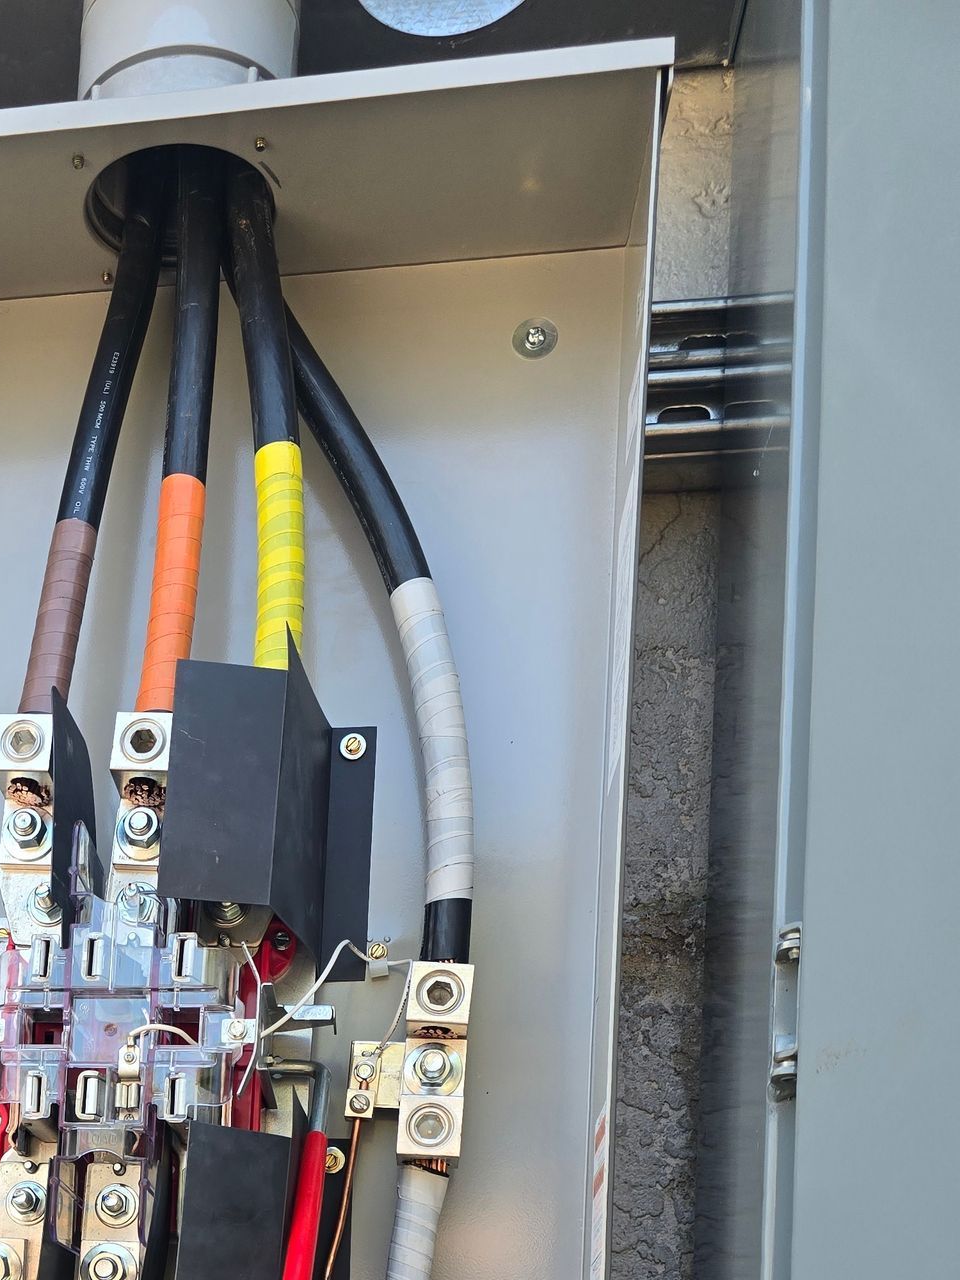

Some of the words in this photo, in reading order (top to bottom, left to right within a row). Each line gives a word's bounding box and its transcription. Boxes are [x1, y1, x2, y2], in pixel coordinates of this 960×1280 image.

[99, 400, 107, 412] 500
[94, 412, 104, 429] MCM
[88, 435, 98, 453] TYPE
[84, 455, 93, 472] THW
[78, 477, 88, 495] 600V
[73, 501, 82, 514] OIL
